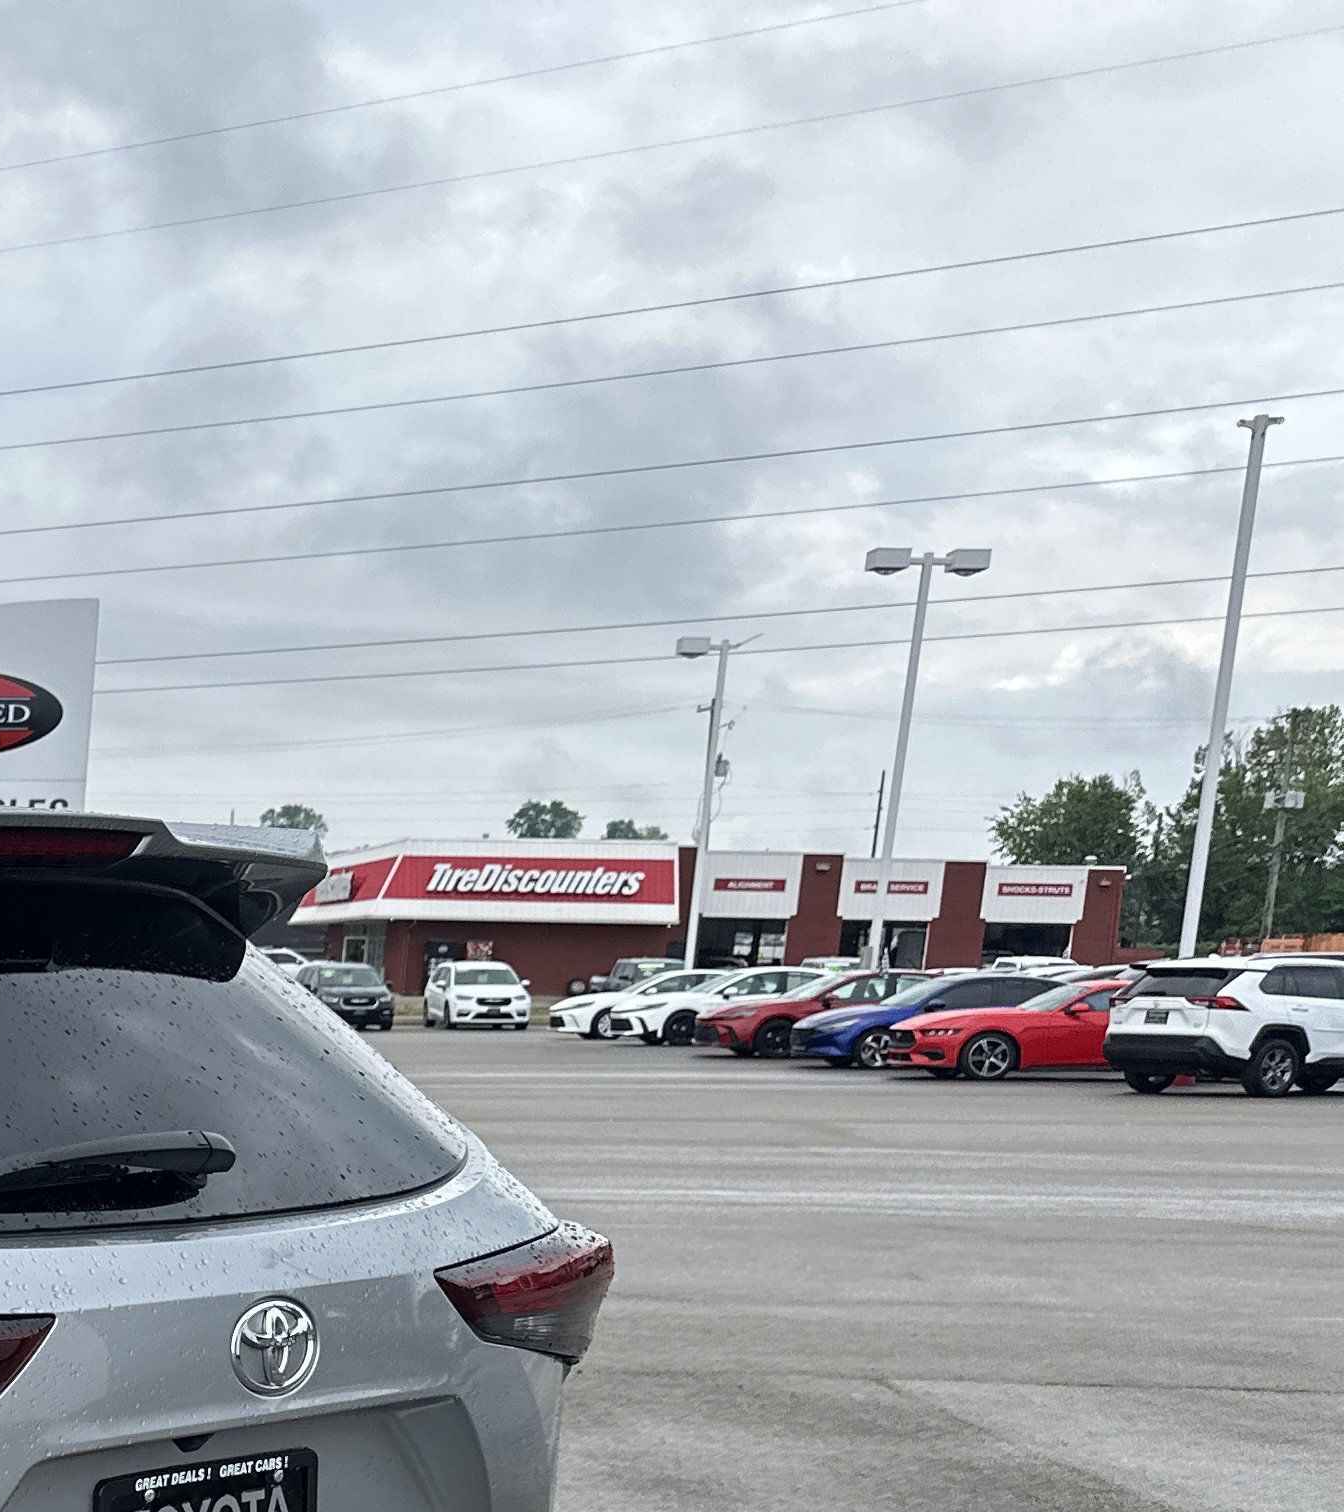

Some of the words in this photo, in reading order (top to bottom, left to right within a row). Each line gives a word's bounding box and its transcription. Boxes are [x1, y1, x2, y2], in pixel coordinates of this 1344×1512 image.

[426, 863, 646, 896] TireDiscounters
[135, 1474, 169, 1491] GREAT
[219, 1461, 254, 1477] GREAT
